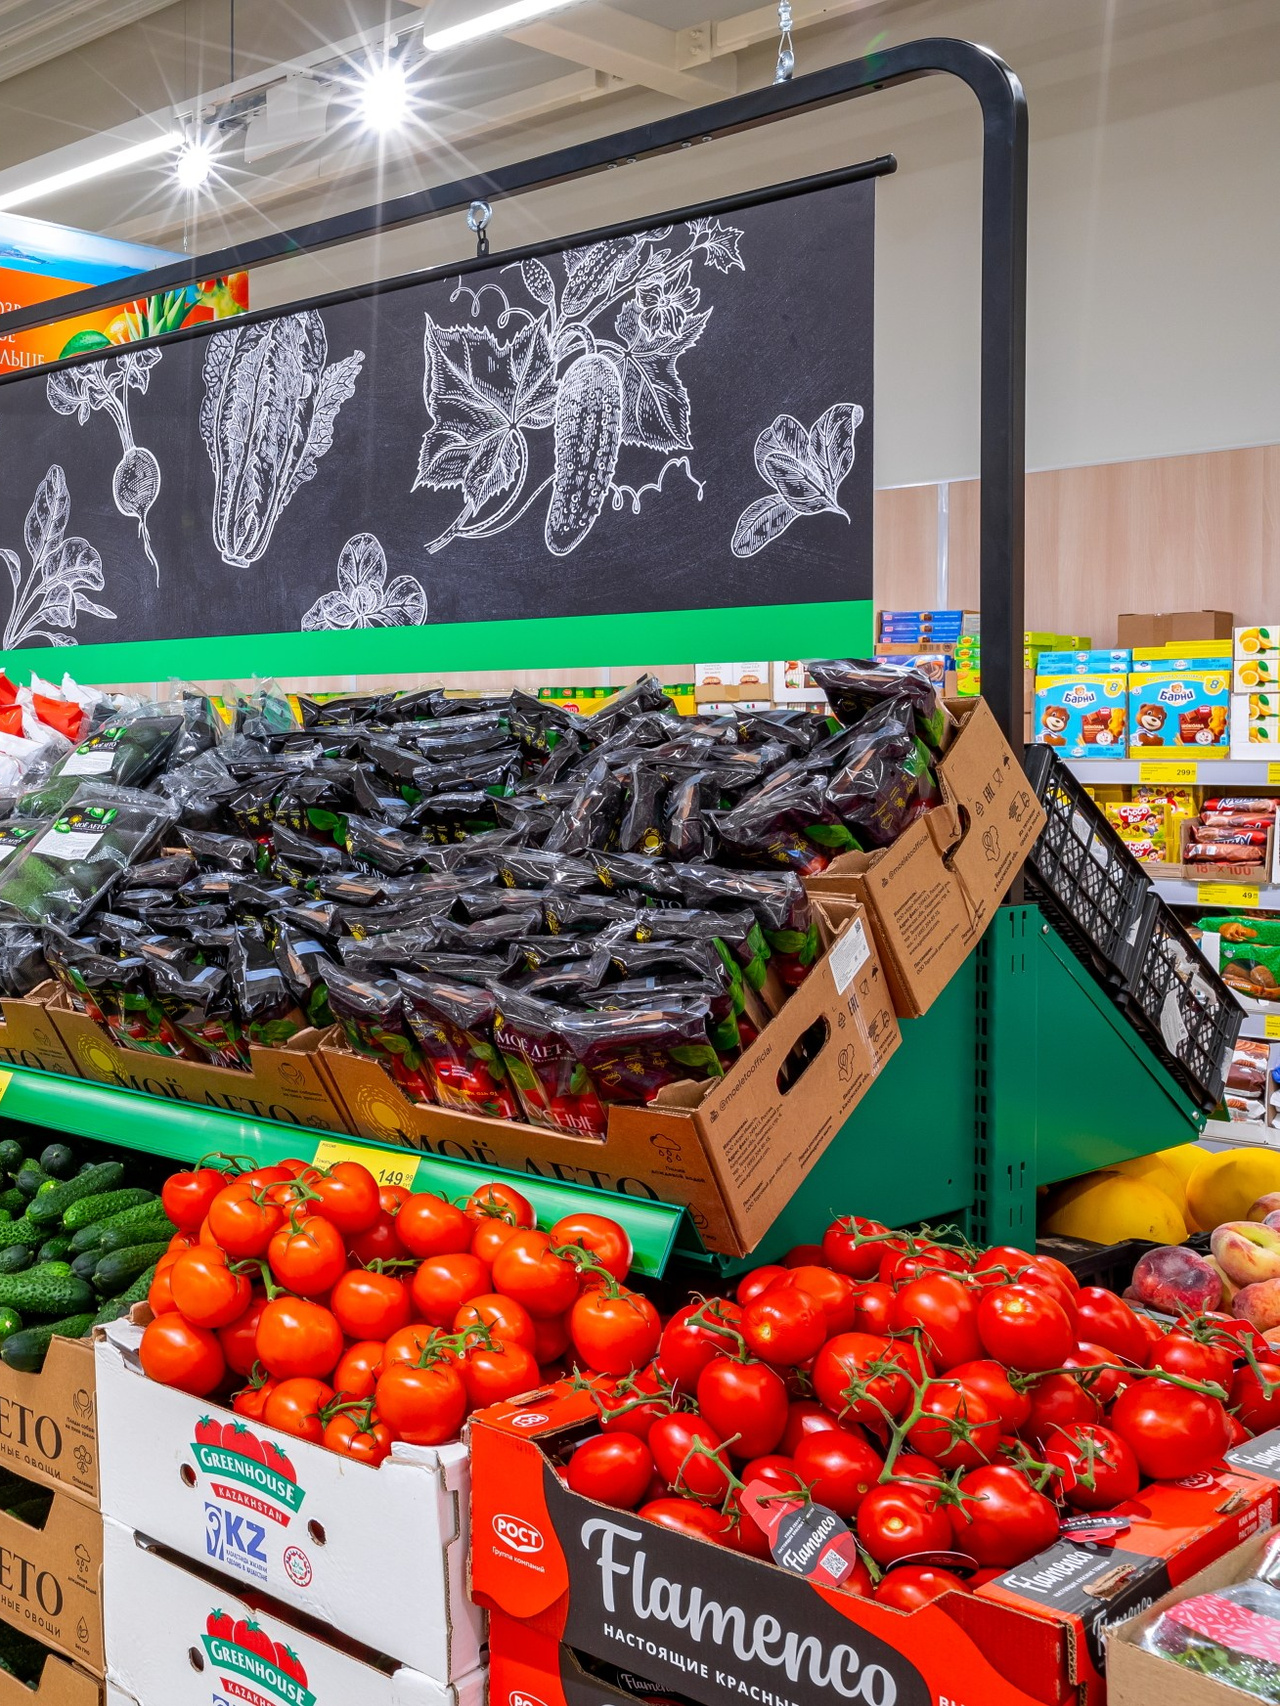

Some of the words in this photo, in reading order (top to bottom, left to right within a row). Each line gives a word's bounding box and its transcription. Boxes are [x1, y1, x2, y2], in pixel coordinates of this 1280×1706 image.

[1064, 692, 1095, 703] Барни
[1110, 683, 1118, 692] 8
[1159, 692, 1194, 702] Барни
[1210, 680, 1219, 689] 8
[1120, 806, 1148, 817] Choco
[87, 823, 108, 831] ЛЕТО
[888, 833, 930, 880] @moeletoofficial
[719, 1043, 773, 1111] @moeletoofficial
[378, 1168, 404, 1186] 149
[405, 1173, 414, 1182] 99
[23, 1450, 62, 1480] ОВОЩИ
[200, 1447, 295, 1505] GREENHOUSE
[218, 1487, 284, 1524] KAZAKHSTAN
[225, 1510, 268, 1563] KZ
[496, 1517, 540, 1544] РОСТ
[782, 1515, 836, 1572] Flamenco
[492, 1545, 513, 1560] Группа
[513, 1551, 546, 1574] компаний
[1003, 1550, 1094, 1594] Flamenco
[24, 1609, 62, 1639] ОВОЩИ
[580, 1517, 898, 1706] Flamenco
[210, 1640, 306, 1706] GREENHOUSE
[603, 1621, 710, 1679] НАСТОЯЩИЕ
[715, 1670, 800, 1706] КРАСНЫ
[227, 1682, 276, 1706] KAZAKH
[620, 1673, 675, 1693] Flame
